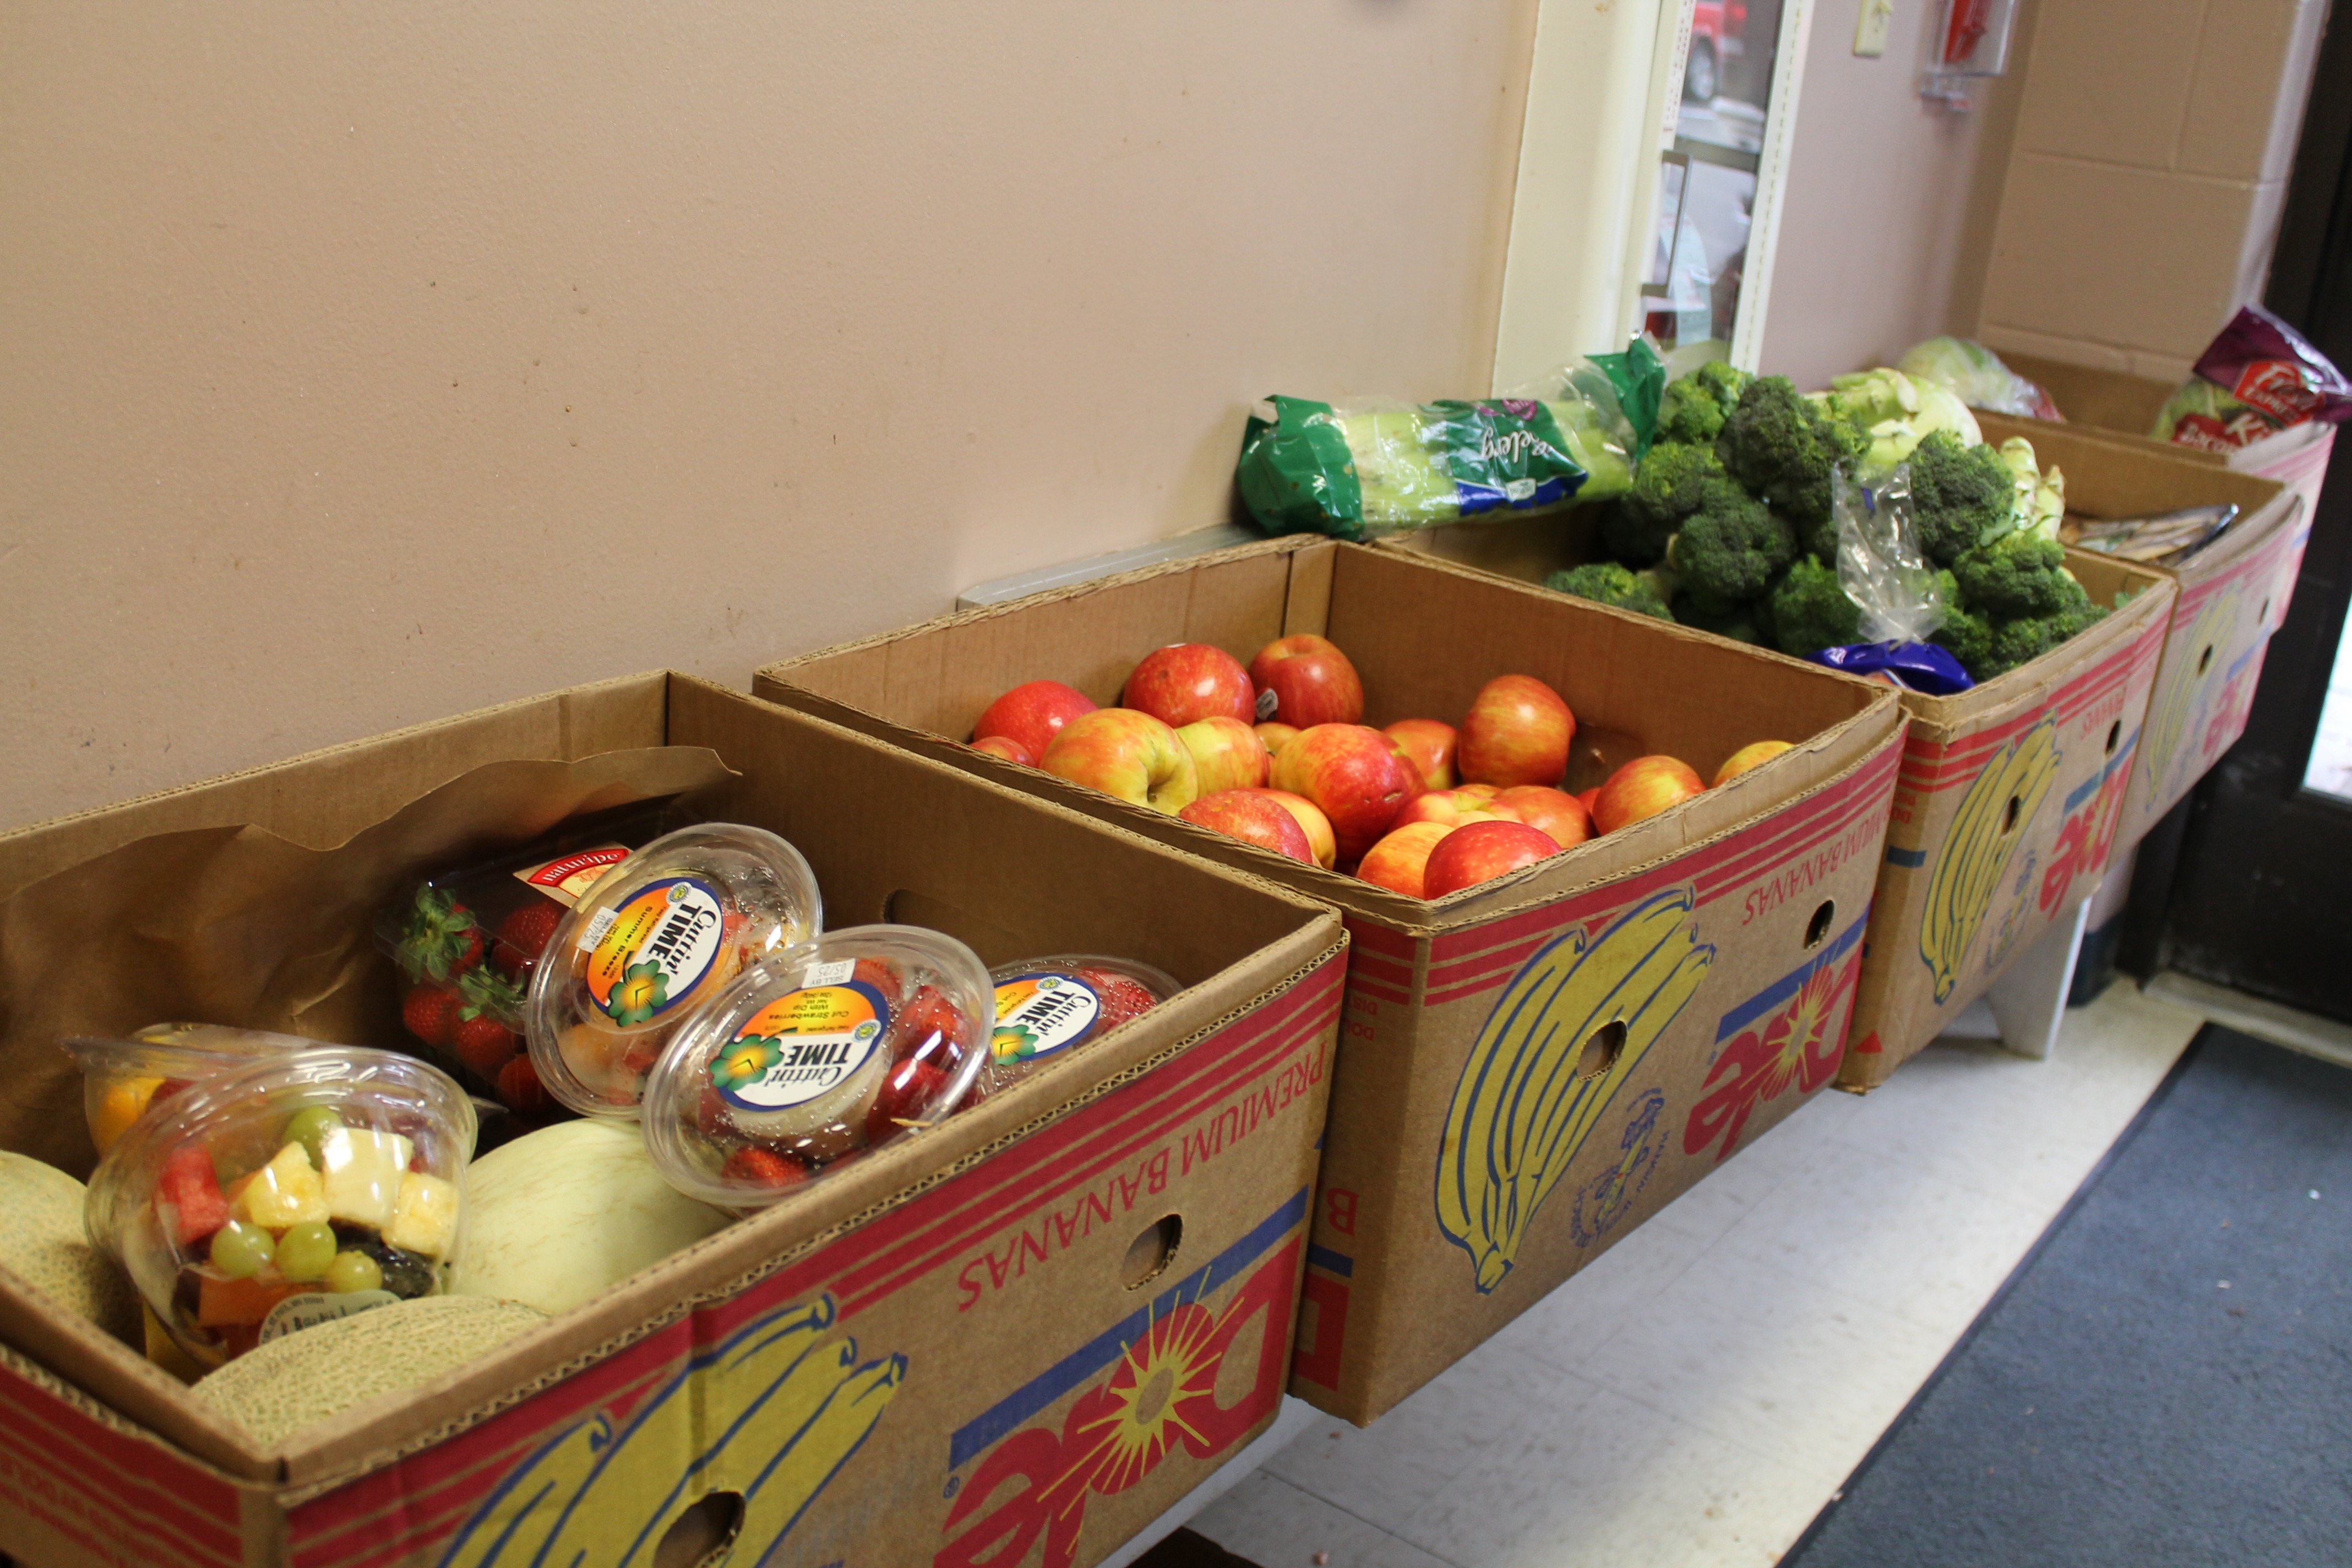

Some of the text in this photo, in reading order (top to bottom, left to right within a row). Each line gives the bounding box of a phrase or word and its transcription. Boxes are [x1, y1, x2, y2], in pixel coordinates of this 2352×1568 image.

[542, 854, 618, 881] naturipe
[1743, 841, 1842, 926] BANANAS
[583, 913, 606, 940] 05/25
[601, 905, 653, 976] Summer Breeze
[647, 903, 701, 960] TIME
[665, 910, 716, 975] Cuttin'
[1015, 990, 1075, 1025] TIME
[1035, 997, 1091, 1036] Cuttin'
[784, 1043, 850, 1066] TIME
[1684, 939, 1865, 1164] Dole
[766, 1068, 841, 1087] Cuttin'
[958, 1041, 1328, 1312] PREMIUM BANANAS
